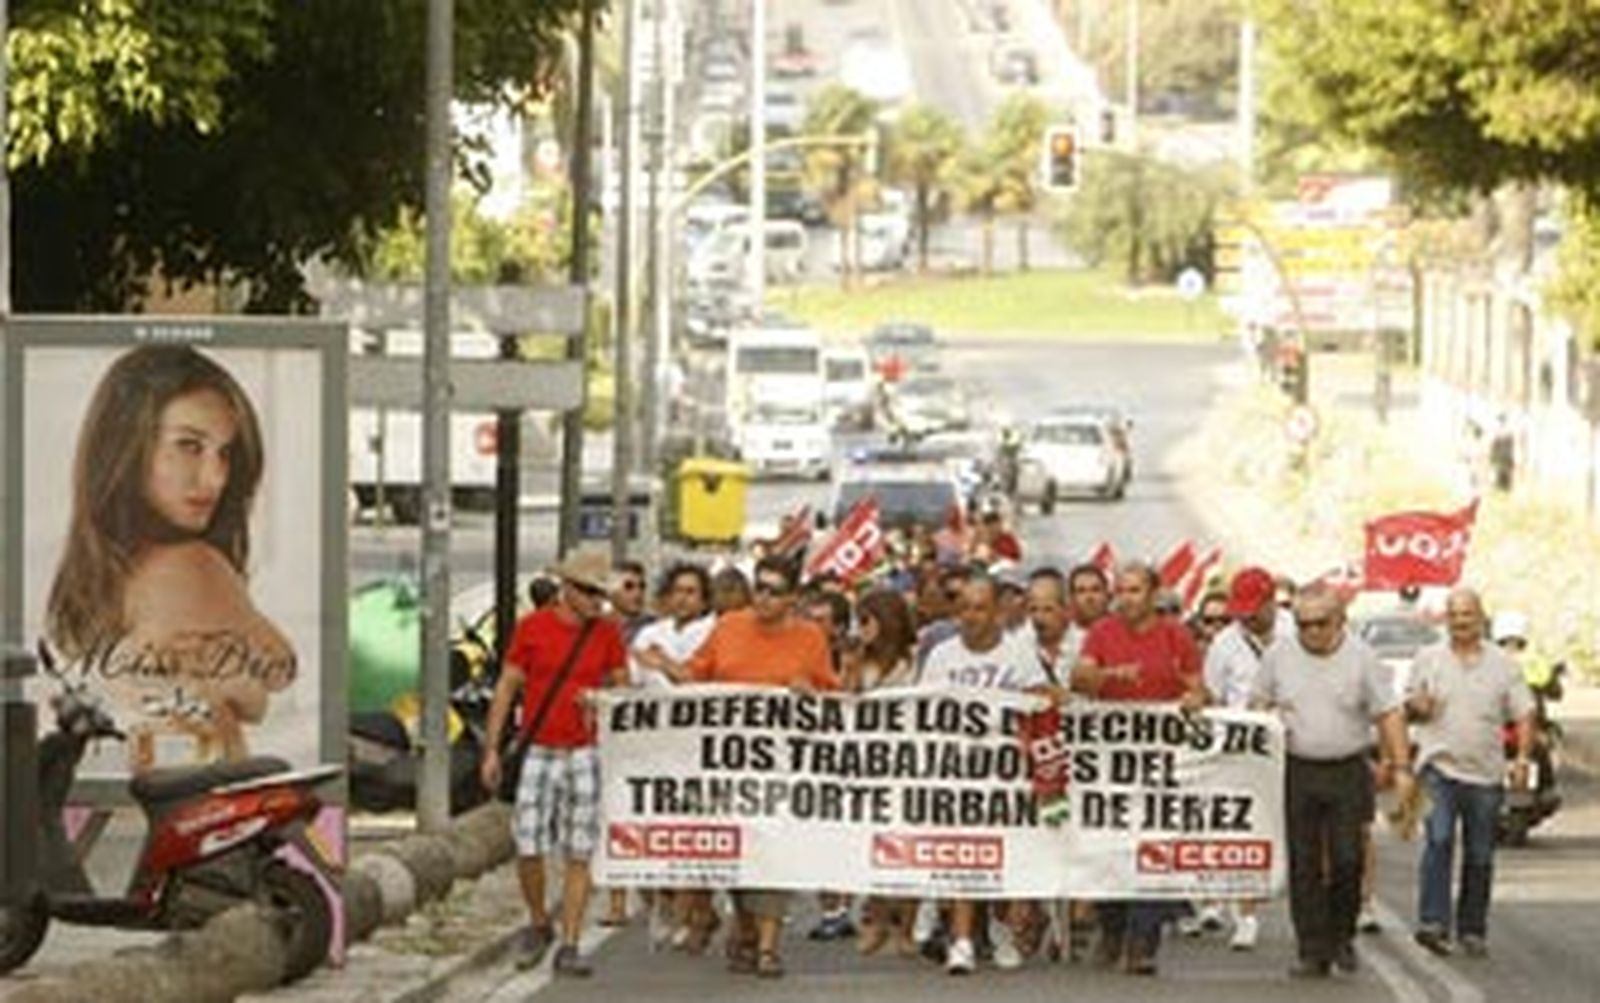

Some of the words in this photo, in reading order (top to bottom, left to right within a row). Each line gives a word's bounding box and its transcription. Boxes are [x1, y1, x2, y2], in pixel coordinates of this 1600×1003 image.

[611, 700, 660, 733] EN
[669, 697, 845, 733] DEFENSA
[855, 700, 905, 732] DE
[917, 698, 990, 737] LOS
[1001, 704, 1213, 751] DECHOS
[1222, 722, 1271, 755] DE
[702, 735, 775, 770] LOS
[787, 737, 1099, 784] TRABAJADOS
[1110, 752, 1182, 788] DEL
[627, 777, 892, 824] TRANSPORTE
[903, 785, 1040, 828] URBAN
[1080, 791, 1130, 828] DE
[1141, 793, 1253, 832] JEREZ
